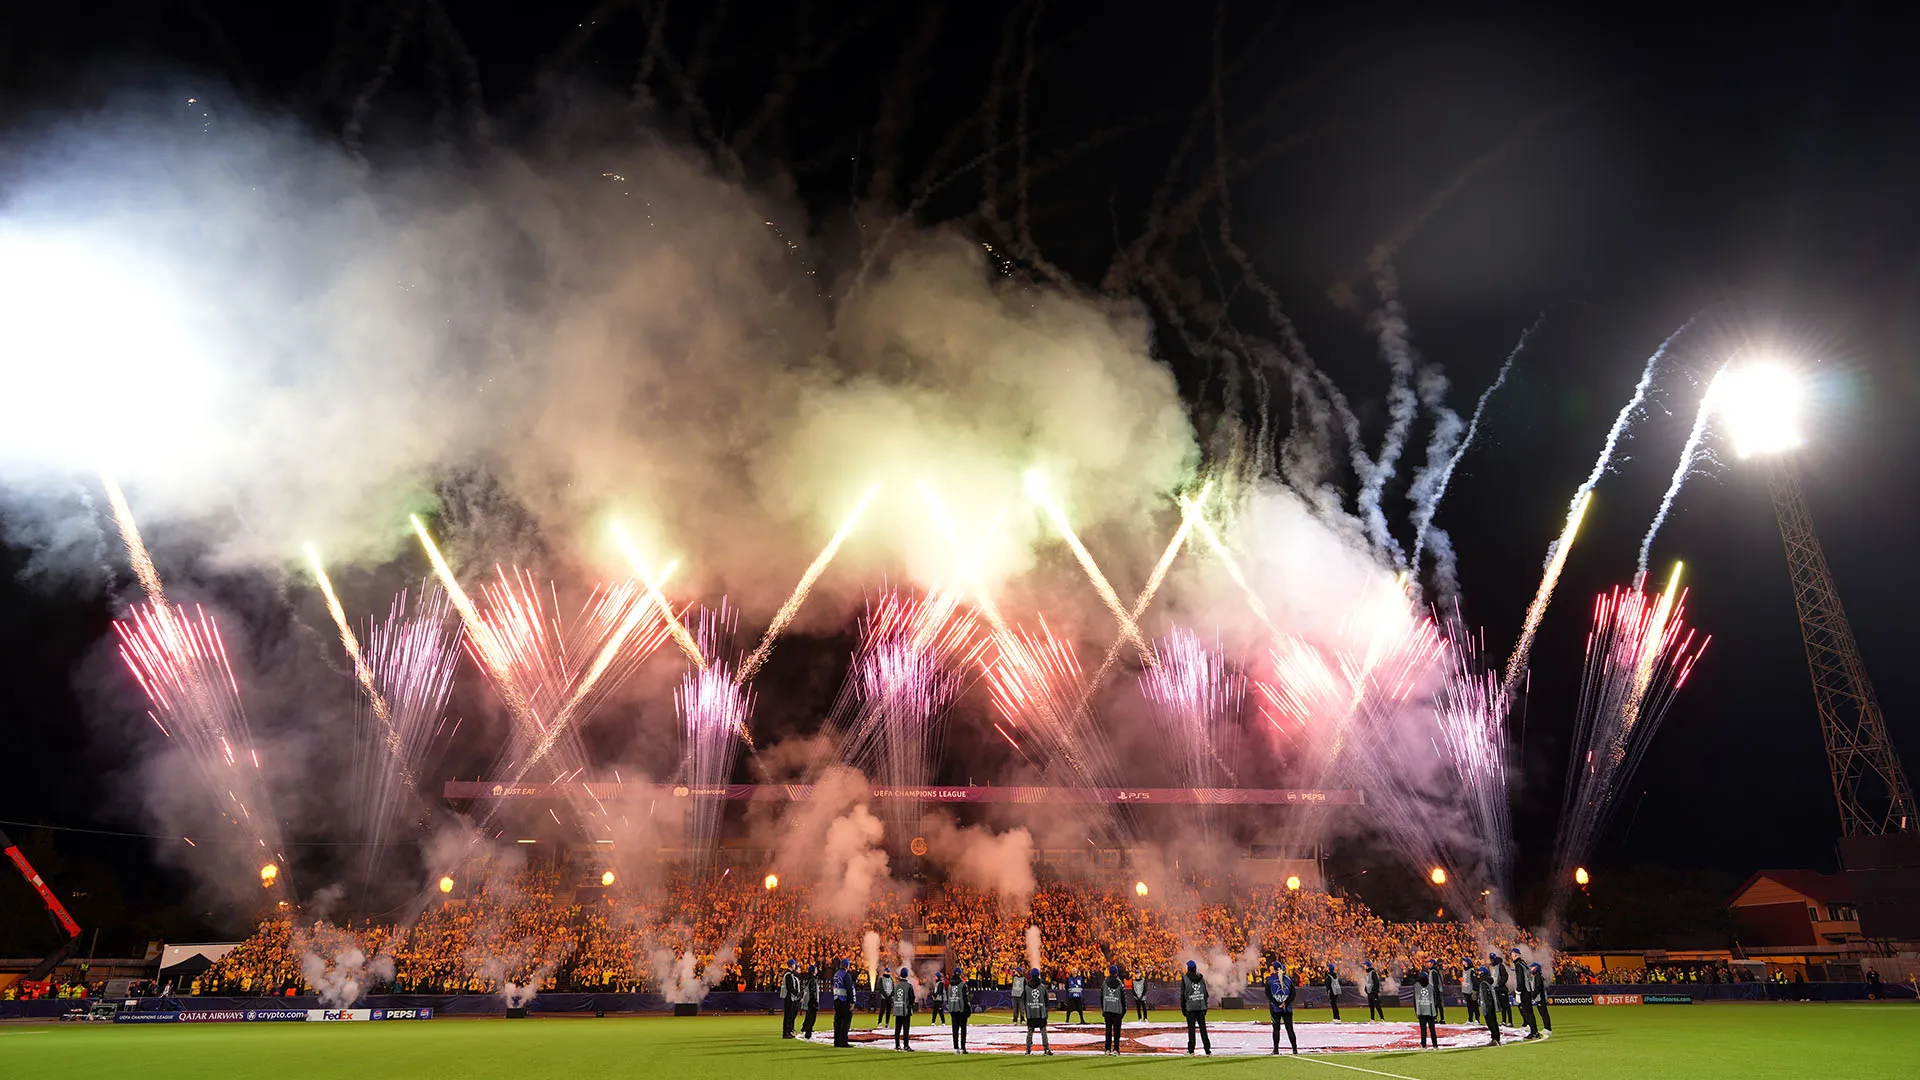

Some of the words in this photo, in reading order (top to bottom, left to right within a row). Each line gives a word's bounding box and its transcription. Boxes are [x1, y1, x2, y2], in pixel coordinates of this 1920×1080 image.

[504, 788, 521, 796] JUST
[690, 788, 726, 796] mastercard
[894, 790, 937, 798] CHAMPIONS
[938, 790, 967, 798] LEAGUE
[1301, 793, 1326, 801] PEPSI
[1554, 996, 1592, 1004] mastercard
[1606, 996, 1624, 1004] JUST
[1625, 996, 1639, 1004] EAT
[178, 1012, 207, 1021] QATAR
[207, 1011, 244, 1020] AIRWAYS
[258, 1011, 304, 1020] crypto.com
[323, 1010, 353, 1021] FedEx
[386, 1010, 416, 1019] PEPSI
